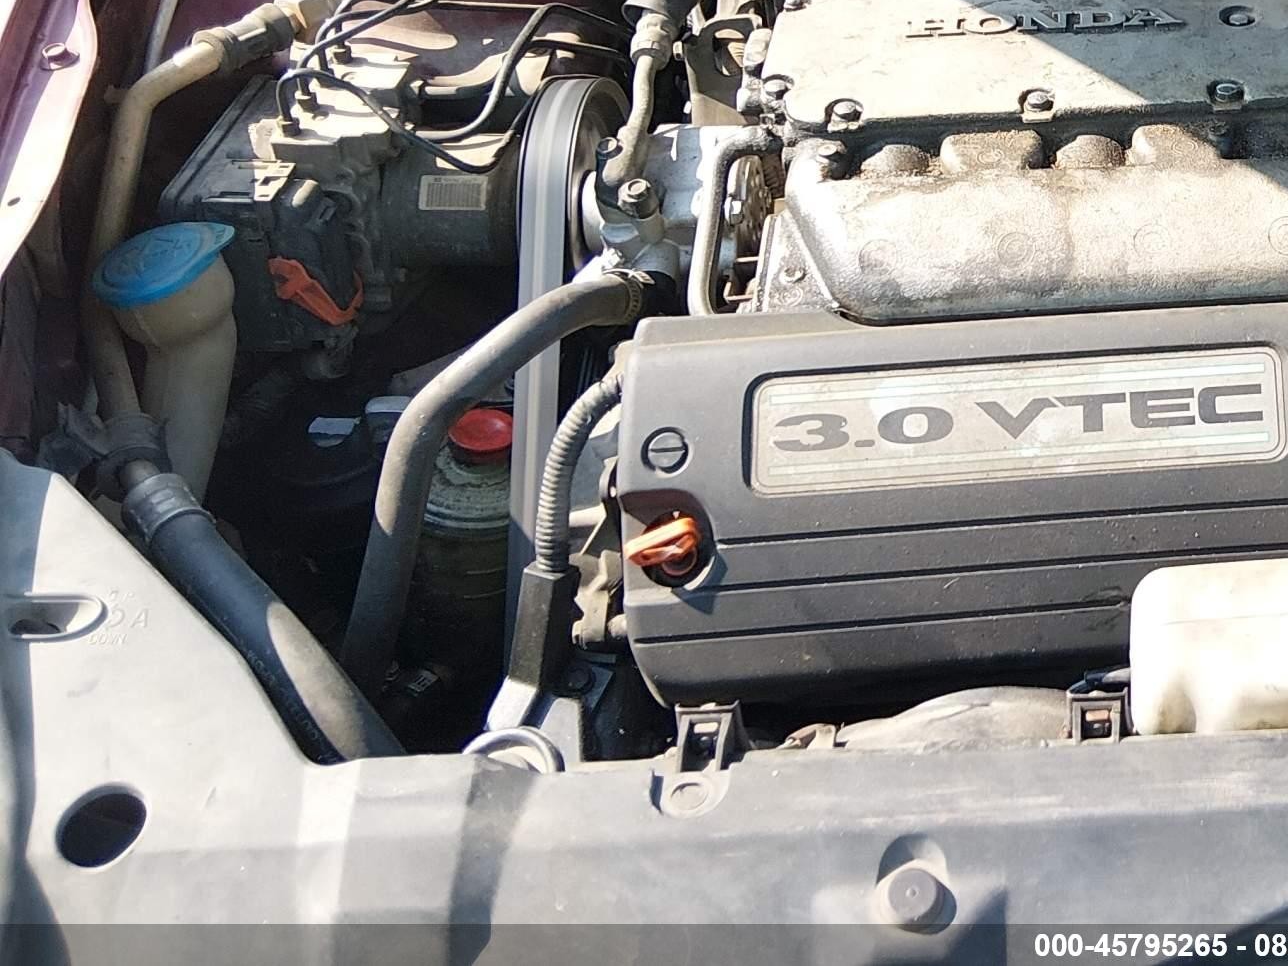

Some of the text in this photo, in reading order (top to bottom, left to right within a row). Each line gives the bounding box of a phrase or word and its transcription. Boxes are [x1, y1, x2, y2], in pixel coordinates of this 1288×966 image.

[904, 5, 1185, 40] HONDA
[772, 382, 1264, 455] 3.0 VTEC
